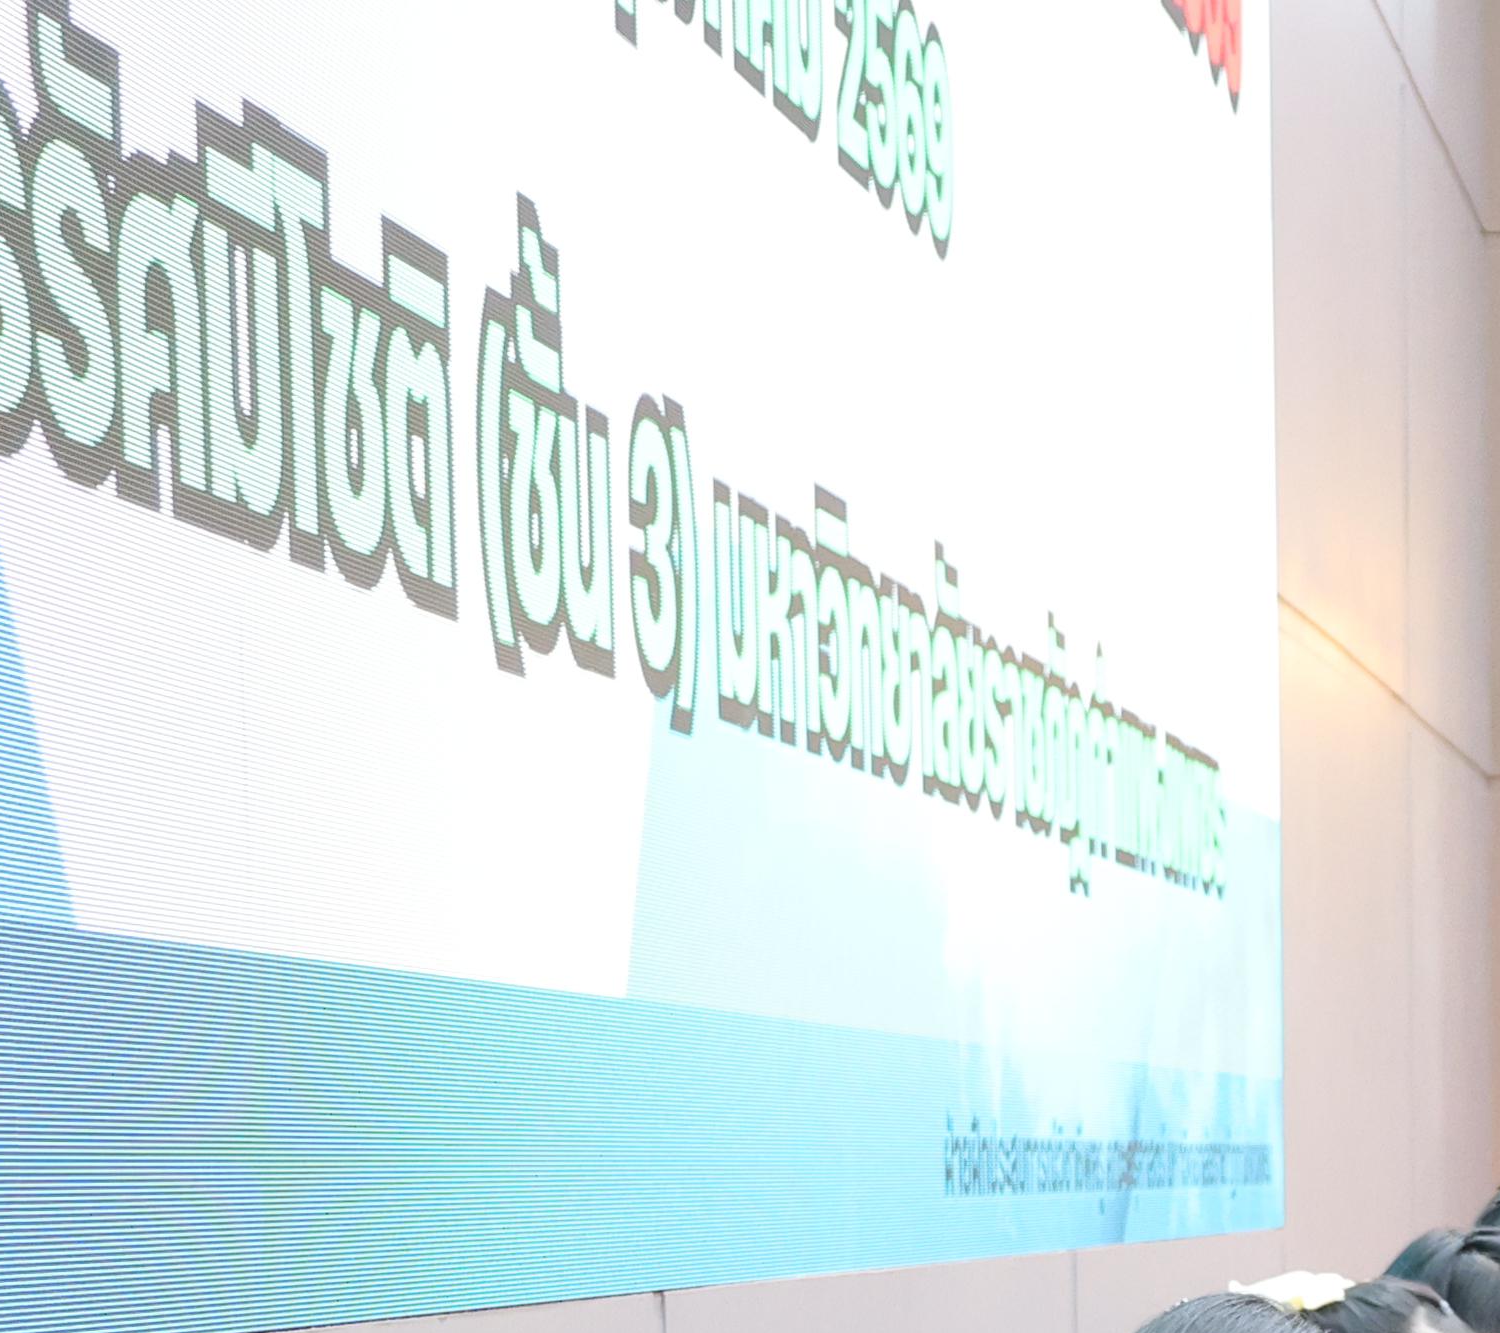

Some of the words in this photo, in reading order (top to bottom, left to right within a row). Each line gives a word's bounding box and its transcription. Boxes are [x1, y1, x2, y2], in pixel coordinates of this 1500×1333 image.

[835, 0, 954, 260] 2569
[477, 193, 616, 679] (ชั้น
[628, 391, 698, 738] 3)
